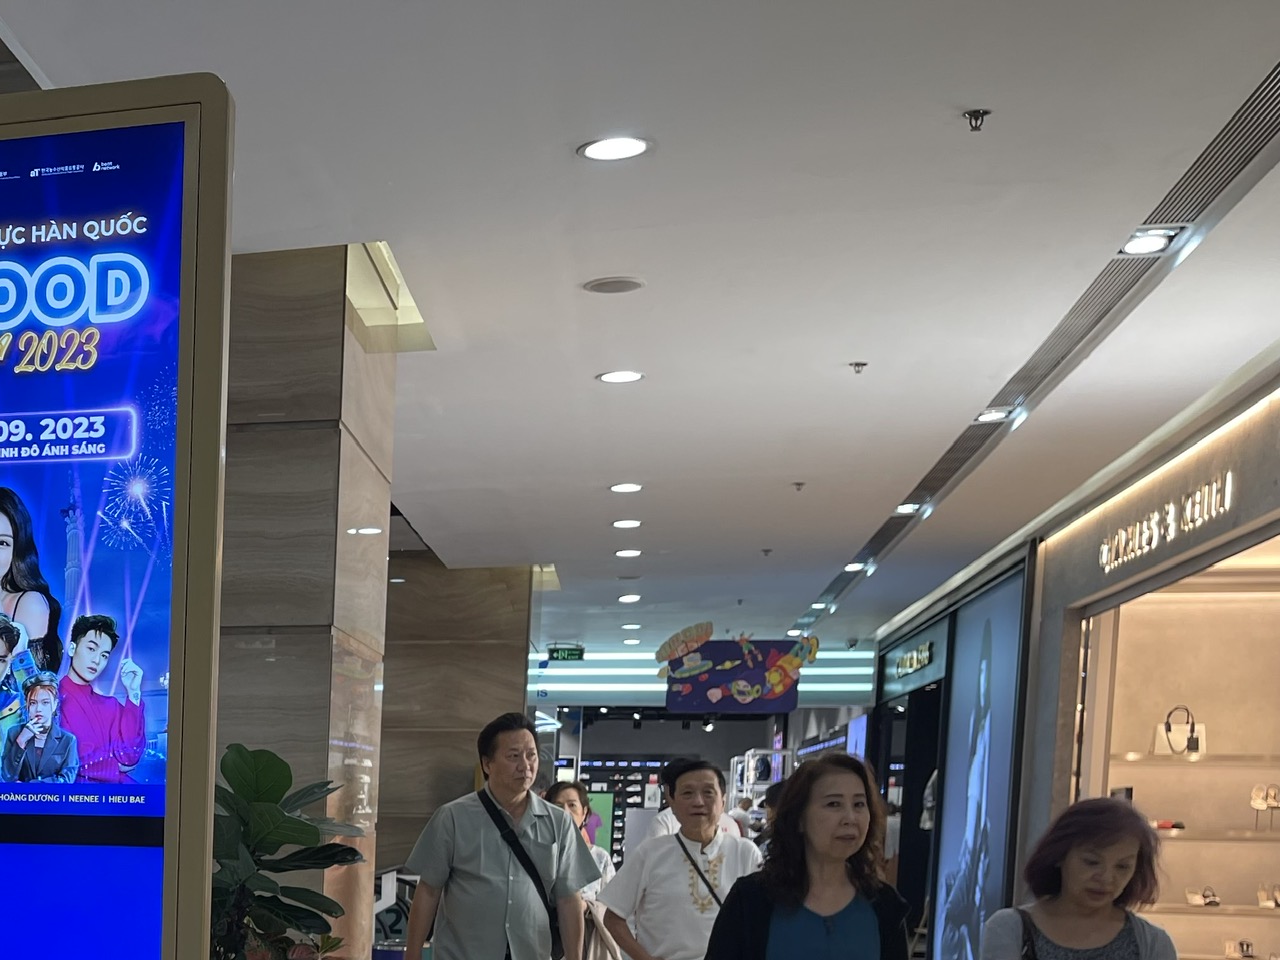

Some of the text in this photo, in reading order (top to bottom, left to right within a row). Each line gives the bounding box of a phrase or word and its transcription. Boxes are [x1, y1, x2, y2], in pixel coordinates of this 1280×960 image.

[31, 220, 77, 243] HÀN
[83, 211, 148, 241] QUỐC
[14, 326, 101, 374] 2023
[39, 416, 106, 440] 2023
[20, 443, 40, 457] ĐÔ
[41, 441, 69, 456] ÁNH
[71, 440, 106, 455] SÁNG
[28, 794, 60, 802] DƯƠNG
[68, 795, 99, 803] NEENEE
[129, 796, 145, 804] BAE
